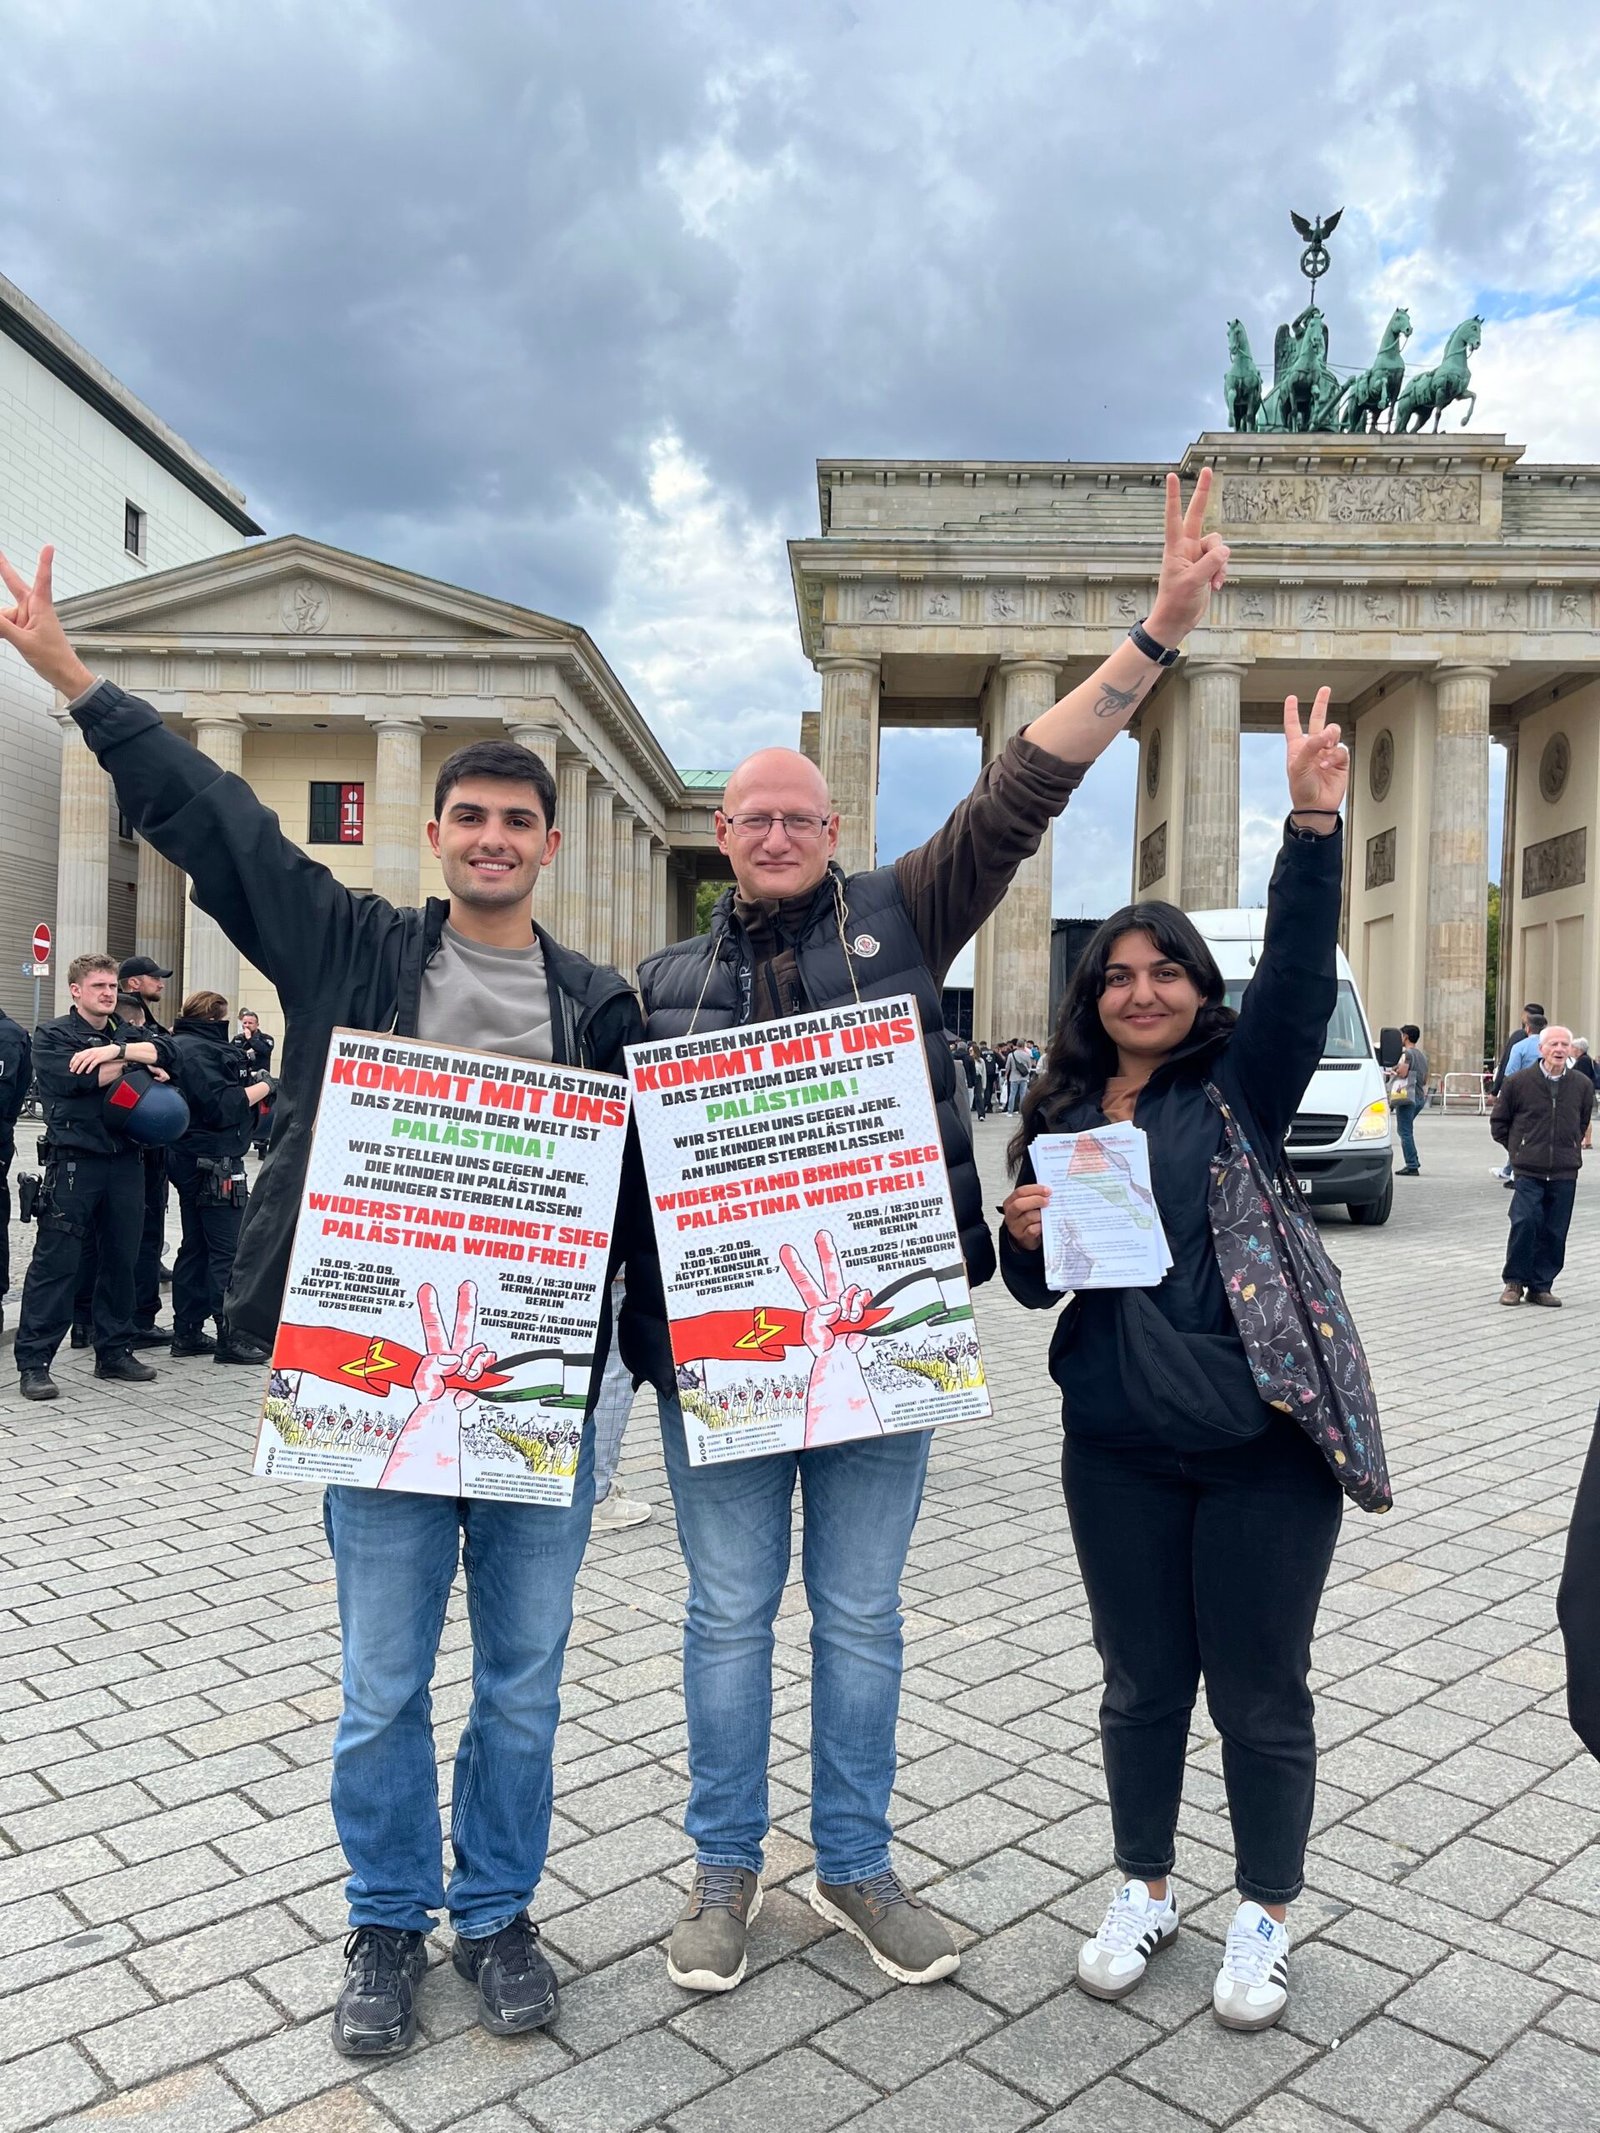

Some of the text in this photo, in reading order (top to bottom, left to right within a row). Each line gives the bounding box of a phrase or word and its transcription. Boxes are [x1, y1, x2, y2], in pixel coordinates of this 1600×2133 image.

[632, 1001, 910, 1066] WIR GEHEN NACH PALÄSTINA!
[634, 1017, 915, 1092] KOMMT MIT UNS
[338, 1041, 627, 1101] WIR GEHEN NACH PALÄSTINA!
[660, 1050, 895, 1107] DAS ZENTRUM DER WELT IST
[330, 1057, 625, 1127] KOMMT MIT UNS
[705, 1080, 846, 1122] PALÄSTINA
[350, 1091, 601, 1142] DAS ZENTRUM DER WELT IST
[672, 1132, 705, 1149] WIR
[706, 1120, 770, 1143] STELLEN
[770, 1113, 805, 1131] UNS
[805, 1103, 856, 1124] GEGEN
[391, 1119, 541, 1158] PALÄSTINA
[694, 1115, 885, 1162] DIE KINDER IN PALÄSTINA
[348, 1139, 382, 1156] WIR
[383, 1144, 453, 1166] STELLEN
[454, 1154, 491, 1171] UNS
[491, 1160, 544, 1179] GEGEN
[681, 1128, 905, 1181] AN HUNGER STERBEN LASSEN!
[364, 1158, 567, 1199] DIE KINDER IN PALÄSTINA
[655, 1145, 939, 1211] WIDERSTAND BRINGT SIEG
[343, 1173, 583, 1218] AN HUNGER STERBEN LASSEN!
[676, 1193, 801, 1231] PALÄSTINA
[803, 1181, 864, 1207] WIRD
[865, 1172, 914, 1196] FREI
[846, 1207, 882, 1222] 20.09.
[889, 1200, 920, 1214] 18:30
[919, 1196, 944, 1208] UHR
[308, 1192, 608, 1249] WIDERSTAND BRINGT SIEG
[852, 1206, 941, 1231] HERMANNPLATZ
[878, 1220, 918, 1236] BERLIN
[321, 1218, 457, 1253] PALÄSTINA
[463, 1237, 525, 1261] WIRD
[527, 1246, 577, 1268] FREI
[684, 1239, 754, 1260] 19.09.-20.09.
[839, 1240, 899, 1259] 21.09.2025
[905, 1234, 934, 1247] 16:00
[934, 1230, 957, 1242] UHR
[844, 1241, 956, 1268] DUISBURG-HAMBORN
[319, 1257, 395, 1276] 19.09.-20.09.
[674, 1256, 769, 1282] ÄGYPT. KONSULAT
[679, 1247, 761, 1271] 11:00-16:00 UHR
[876, 1256, 927, 1273] RATHAUS
[300, 1274, 407, 1299] ÄGYPT. KONSULAT
[310, 1266, 401, 1287] 11:00-16:00 UHR
[497, 1271, 534, 1285] 20.09.
[543, 1277, 573, 1290] 18:30
[573, 1281, 597, 1293] UHR
[666, 1265, 780, 1293] STAUFFENBERGER STR. 6-7
[695, 1279, 755, 1297] 10785 BERLIN
[289, 1286, 415, 1309] STAUFFENBERGER STR. 6-7
[500, 1282, 591, 1302] HERMANNPLATZ
[524, 1295, 565, 1309] BERLIN
[318, 1299, 383, 1315] 10785 BERLIN
[478, 1306, 539, 1322] 21.09.2025
[546, 1314, 575, 1326] 16:00
[575, 1318, 598, 1329] UHR
[480, 1317, 593, 1339] DUISBURG-HAMBORN
[510, 1331, 561, 1345] RATHAUS
